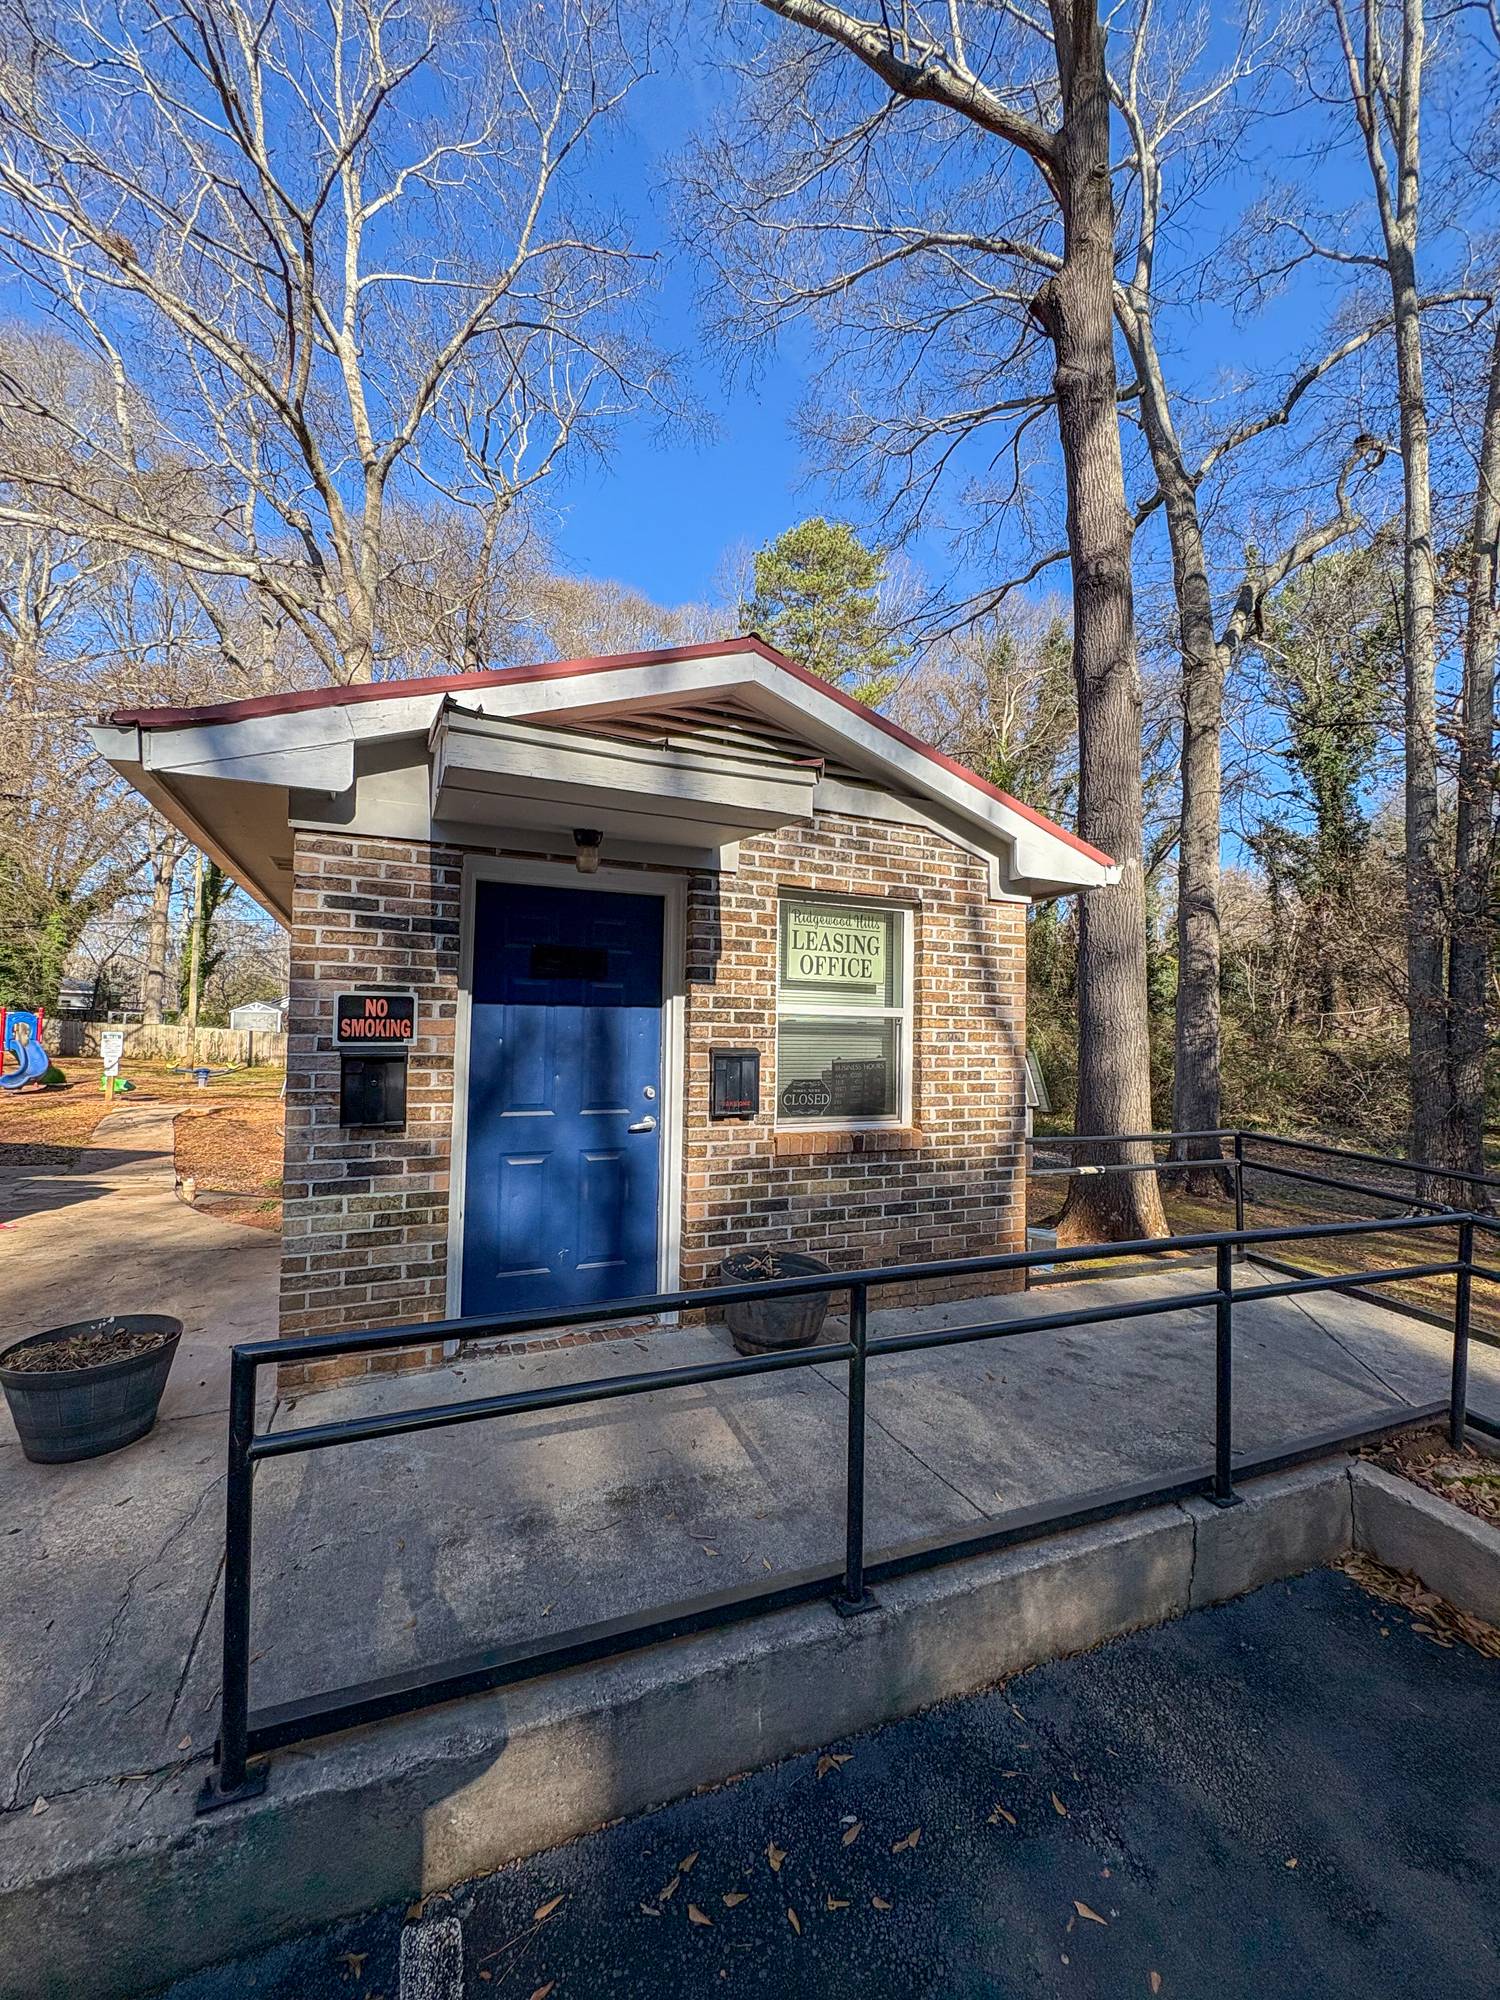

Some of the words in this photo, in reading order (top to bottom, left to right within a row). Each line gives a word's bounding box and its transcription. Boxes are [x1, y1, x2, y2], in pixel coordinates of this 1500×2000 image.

[792, 908, 852, 929] Ridgewood
[854, 914, 880, 930] Hills
[791, 929, 880, 956] LEASING
[799, 954, 872, 978] OFFICE
[365, 998, 388, 1017] NO
[340, 1018, 411, 1038] SMOKING
[783, 1093, 830, 1106] CLOSED
